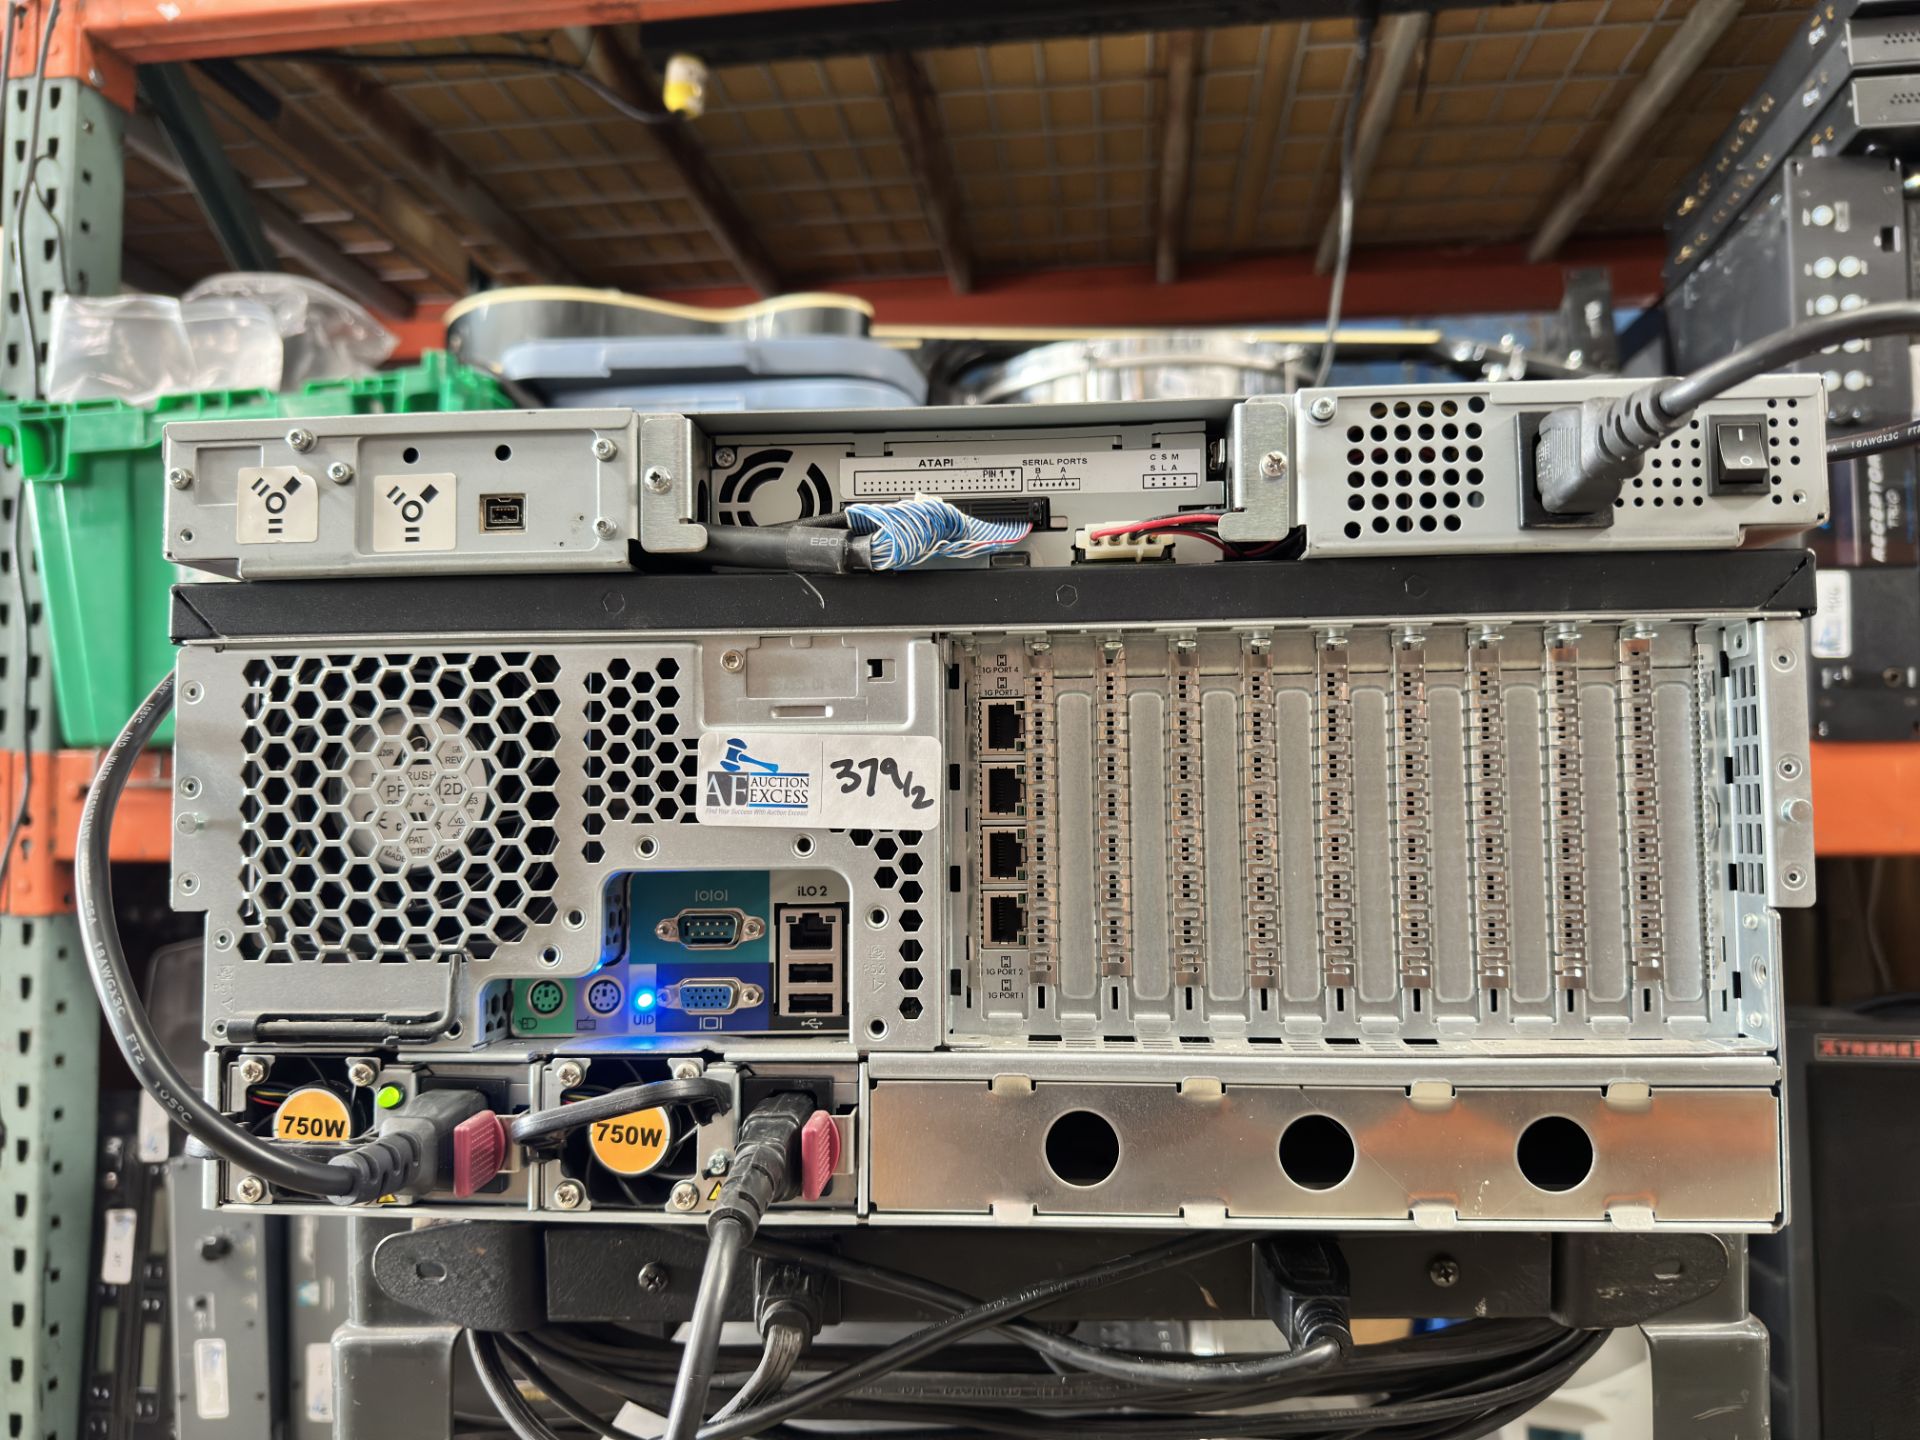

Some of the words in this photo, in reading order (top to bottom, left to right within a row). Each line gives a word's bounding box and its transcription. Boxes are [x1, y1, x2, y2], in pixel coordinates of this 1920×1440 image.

[1851, 431, 1899, 449] 18AWGX3C
[918, 458, 954, 468] ATAPI
[1022, 459, 1054, 467] SERIAL
[1057, 457, 1088, 465] PORTS
[983, 469, 997, 478] PIN
[1000, 469, 1004, 478] 1
[118, 731, 133, 748] AND
[750, 776, 809, 788] AUCTION
[750, 788, 809, 804] EXCESS
[797, 885, 818, 897] iLO
[820, 886, 828, 897] 2
[85, 899, 97, 926] CSA
[94, 941, 126, 1016] 18AWGX3C
[633, 1015, 655, 1025] UID
[126, 1033, 145, 1065] FT2
[283, 1115, 346, 1138] 750W
[596, 1122, 663, 1147] 750W
